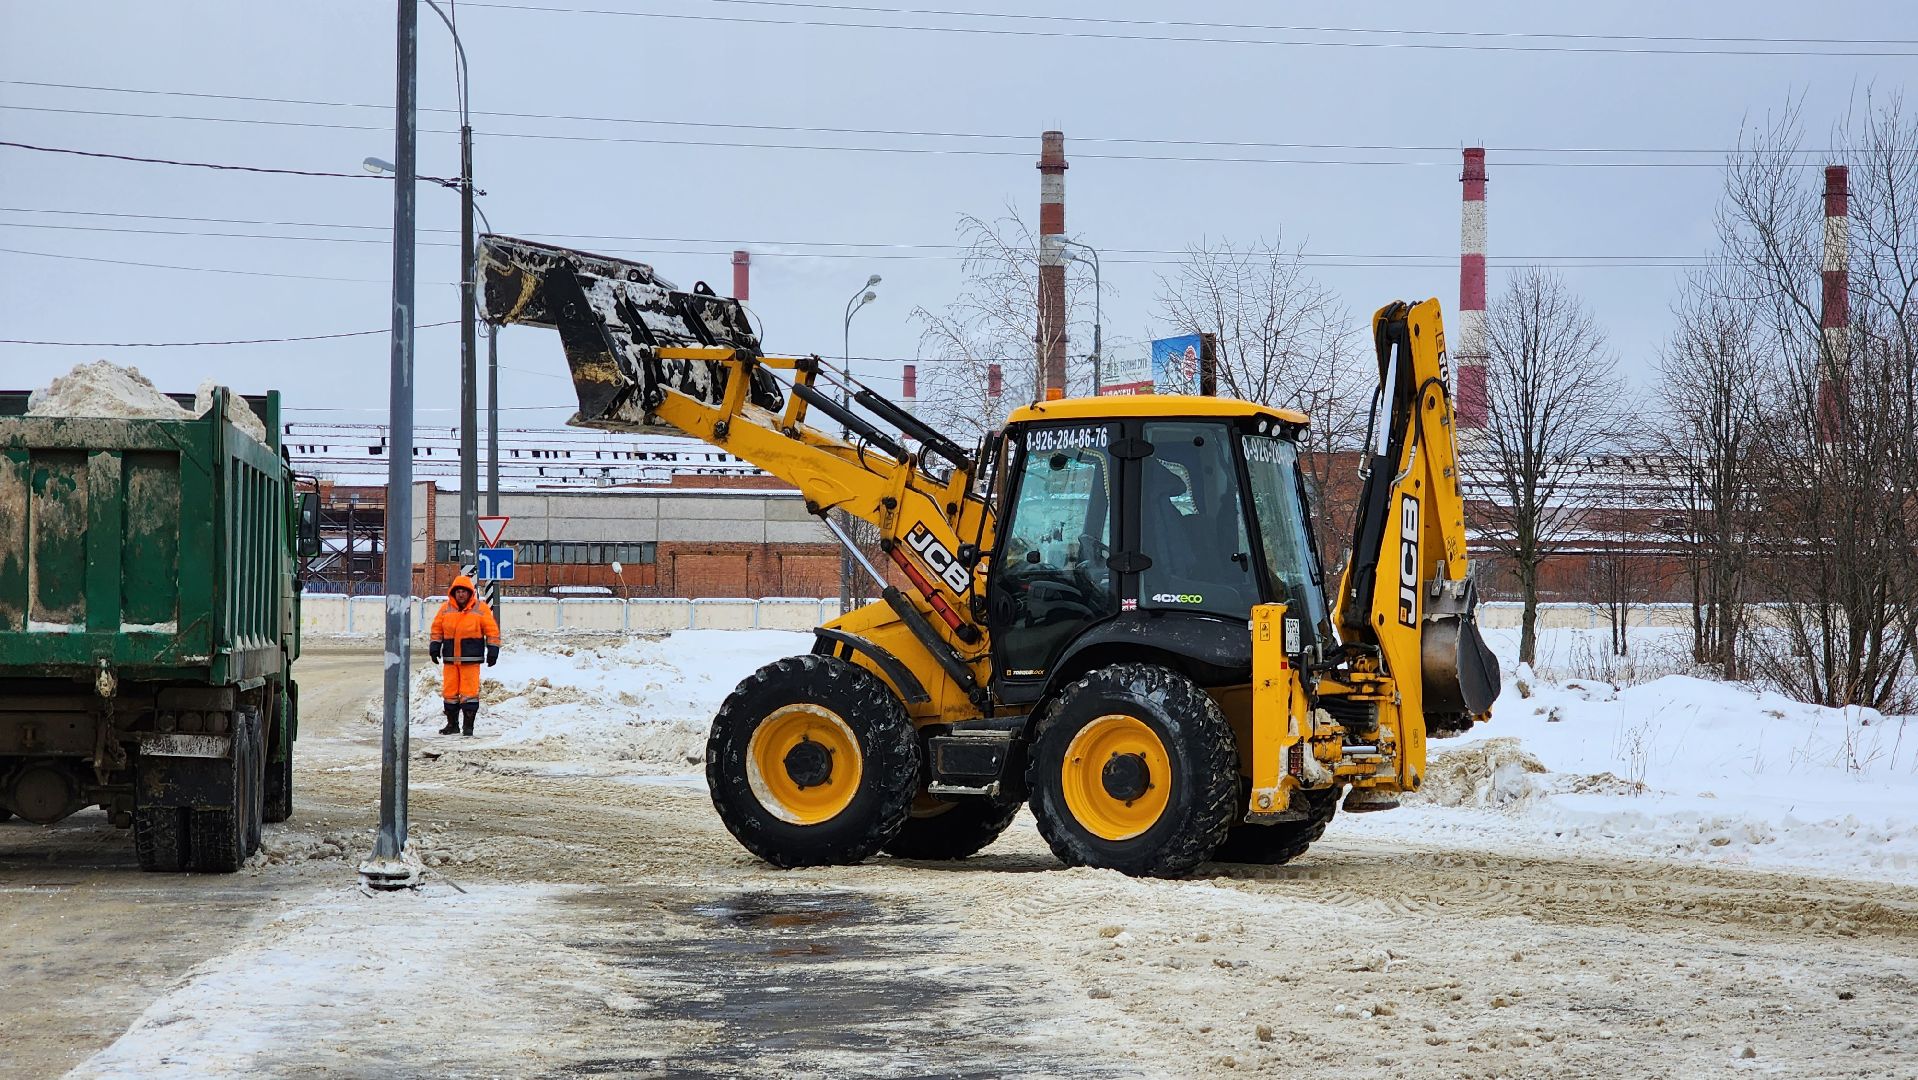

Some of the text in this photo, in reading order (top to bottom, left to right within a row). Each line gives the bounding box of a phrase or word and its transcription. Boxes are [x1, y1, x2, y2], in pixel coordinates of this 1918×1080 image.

[1026, 428, 1107, 451] 8-926-284-86-76
[907, 531, 969, 593] JCB
[1400, 498, 1418, 624] JCB
[1287, 620, 1299, 633] 3952
